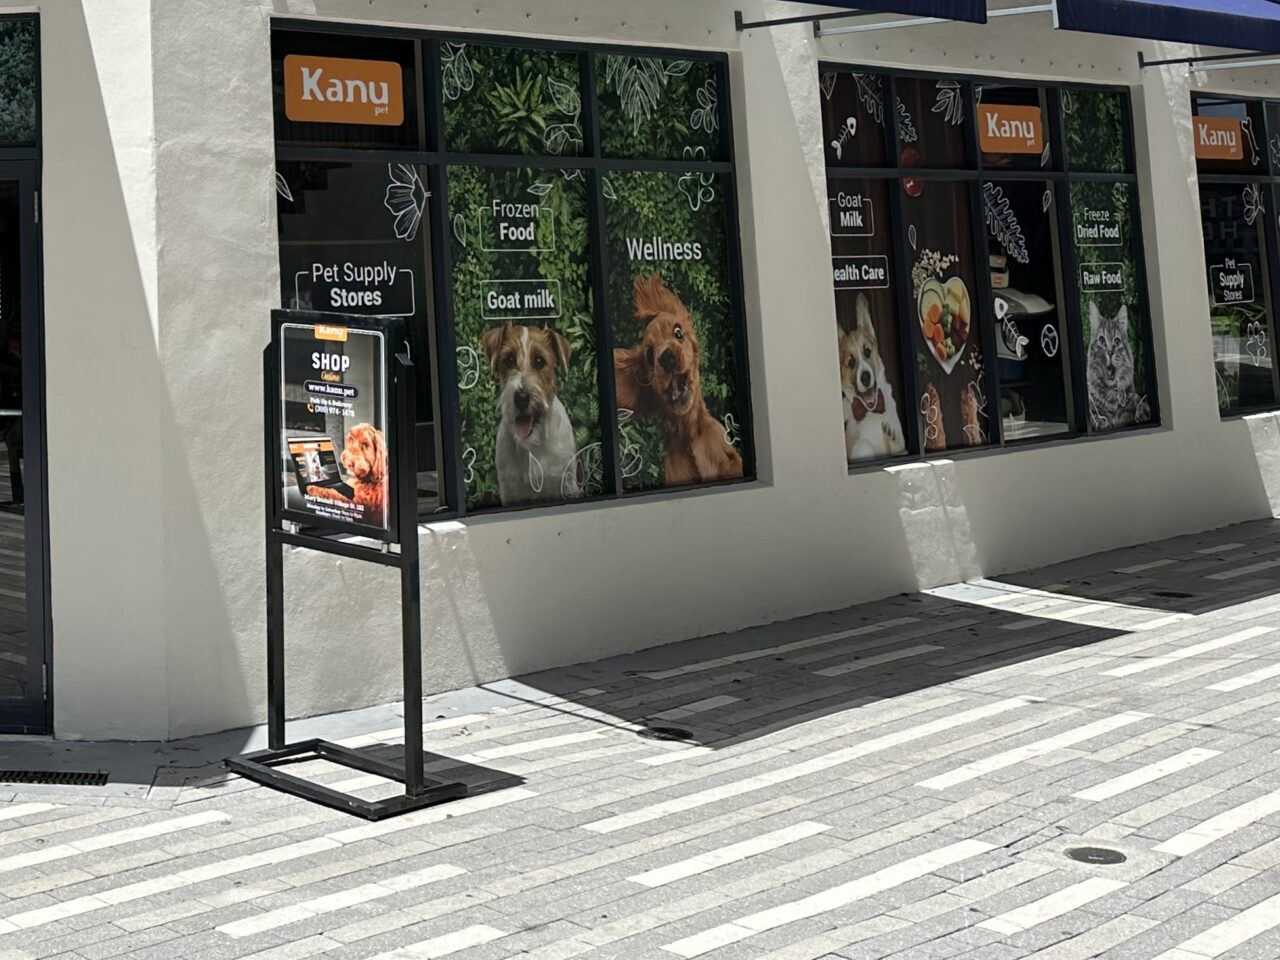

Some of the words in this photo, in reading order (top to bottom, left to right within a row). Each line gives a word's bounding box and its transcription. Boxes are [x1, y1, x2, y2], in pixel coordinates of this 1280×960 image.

[300, 66, 389, 106] Kanu
[375, 104, 389, 117] pet
[986, 112, 1035, 138] Kanu
[1198, 123, 1236, 146] Kanu
[837, 192, 862, 207] Goat
[492, 200, 540, 218] Frozen
[1084, 207, 1110, 221] Freeze
[840, 211, 863, 227] Milk
[499, 222, 535, 241] Food
[1077, 224, 1098, 238] Dried
[1100, 224, 1120, 238] Food
[626, 238, 702, 261] Wellness
[1225, 258, 1236, 269] Pet
[312, 263, 339, 282] Pet
[342, 263, 397, 287] Supply
[861, 265, 885, 280] Care
[1083, 271, 1100, 285] Raw
[1102, 270, 1122, 284] Food
[1220, 272, 1244, 288] Supply
[329, 286, 382, 307] Stores
[486, 291, 521, 309] Goat
[524, 290, 554, 308] milk
[1223, 288, 1243, 301] Stores
[312, 352, 350, 372] SHOP
